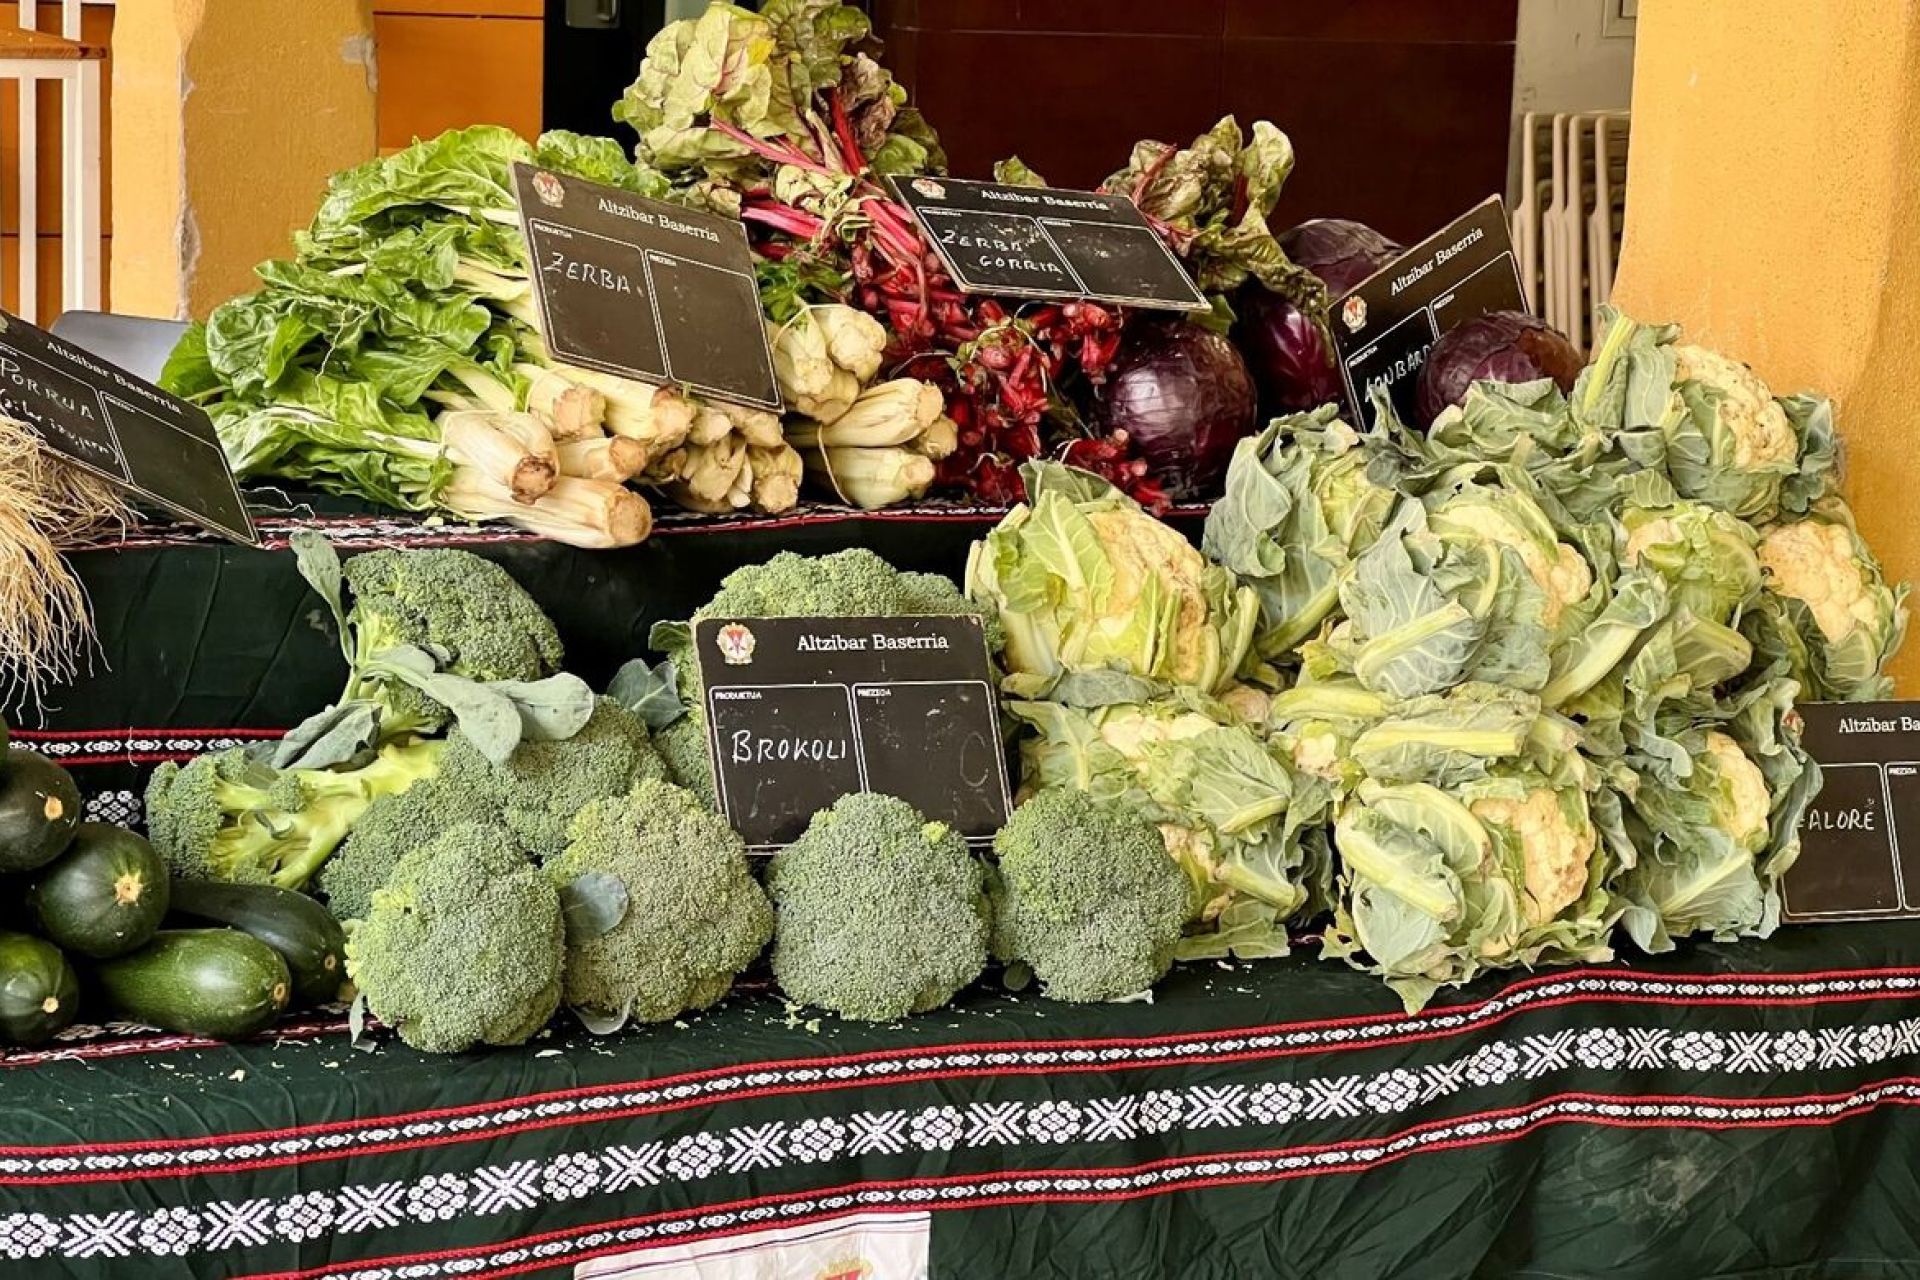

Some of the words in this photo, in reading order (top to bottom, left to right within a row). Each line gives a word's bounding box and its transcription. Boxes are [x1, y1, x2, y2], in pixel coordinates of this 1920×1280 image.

[982, 188, 1039, 203] Altzibar
[1042, 195, 1110, 211] Baserria
[598, 197, 655, 224] Altzibar
[658, 213, 720, 243] Baserria
[543, 252, 631, 294] ZERBA
[979, 255, 1064, 275] GORRIA
[1390, 258, 1435, 296] Altzibar
[1435, 227, 1485, 266] Baserria
[47, 341, 109, 378] Altzibar
[112, 372, 183, 415] Baserria
[796, 633, 867, 651] Altzibar
[872, 632, 949, 651] Baserria
[1838, 717, 1896, 733] Altzibar
[731, 729, 847, 765] BROKOLI
